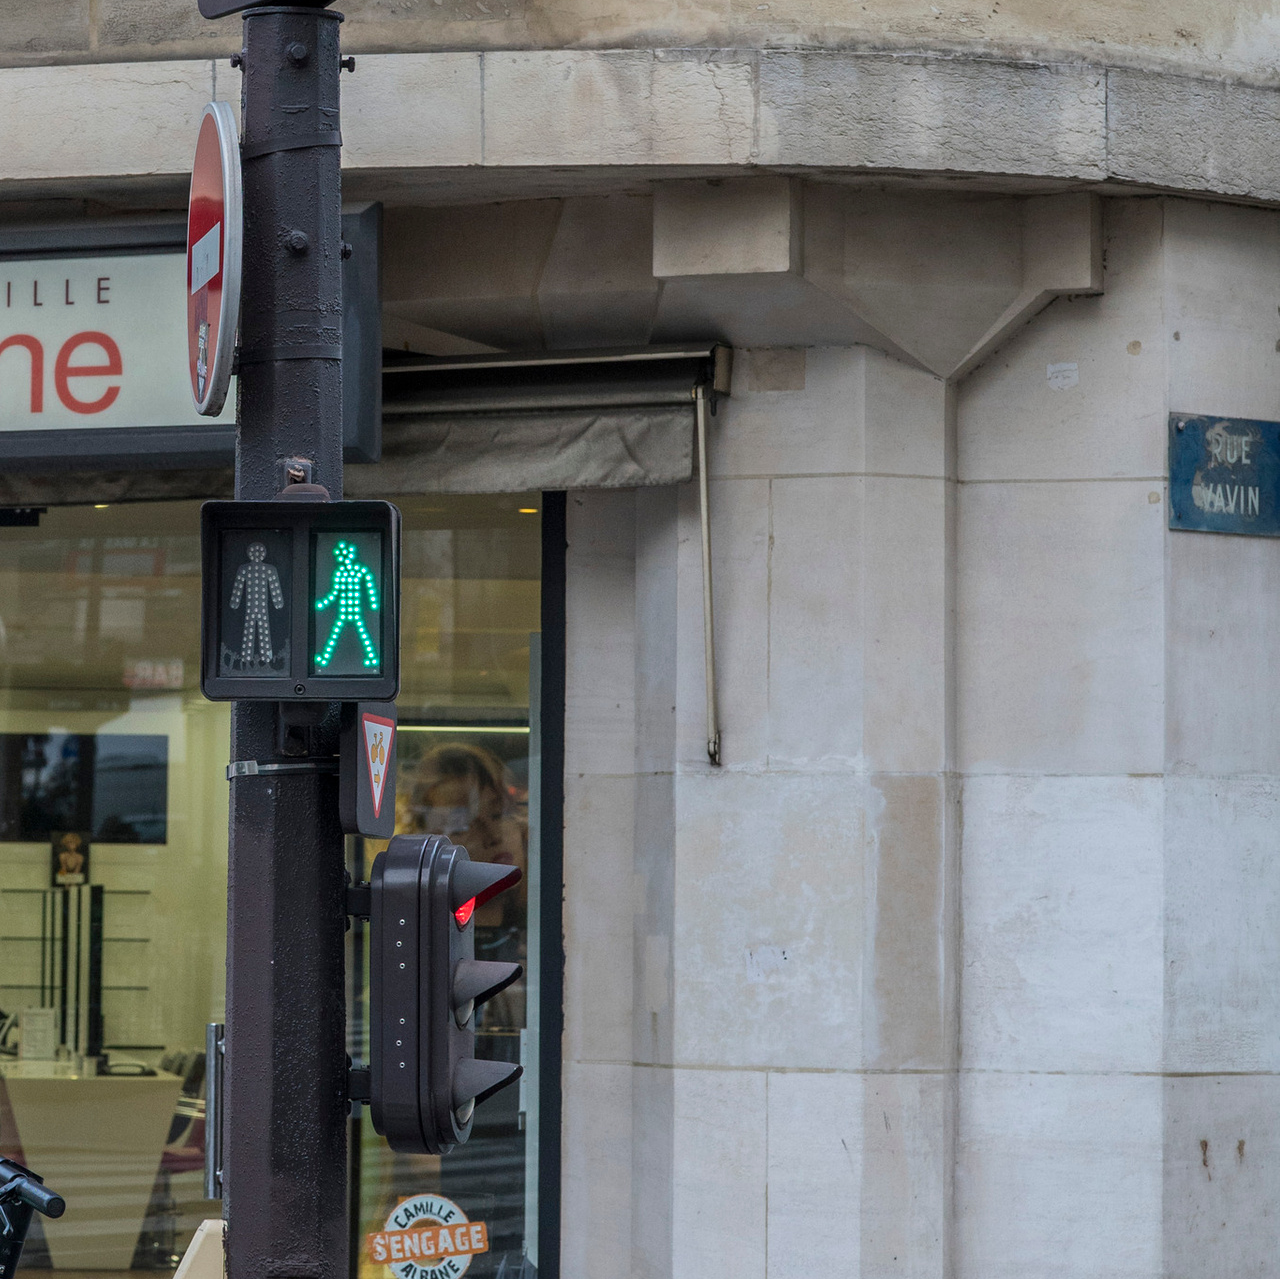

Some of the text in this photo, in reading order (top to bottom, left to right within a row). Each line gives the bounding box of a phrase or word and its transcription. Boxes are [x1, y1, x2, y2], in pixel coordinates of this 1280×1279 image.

[1211, 435, 1251, 467] RUE
[1201, 483, 1260, 516] VAVIN
[394, 1201, 456, 1229] CAMILLE
[372, 1224, 485, 1262] S'ENGAGE
